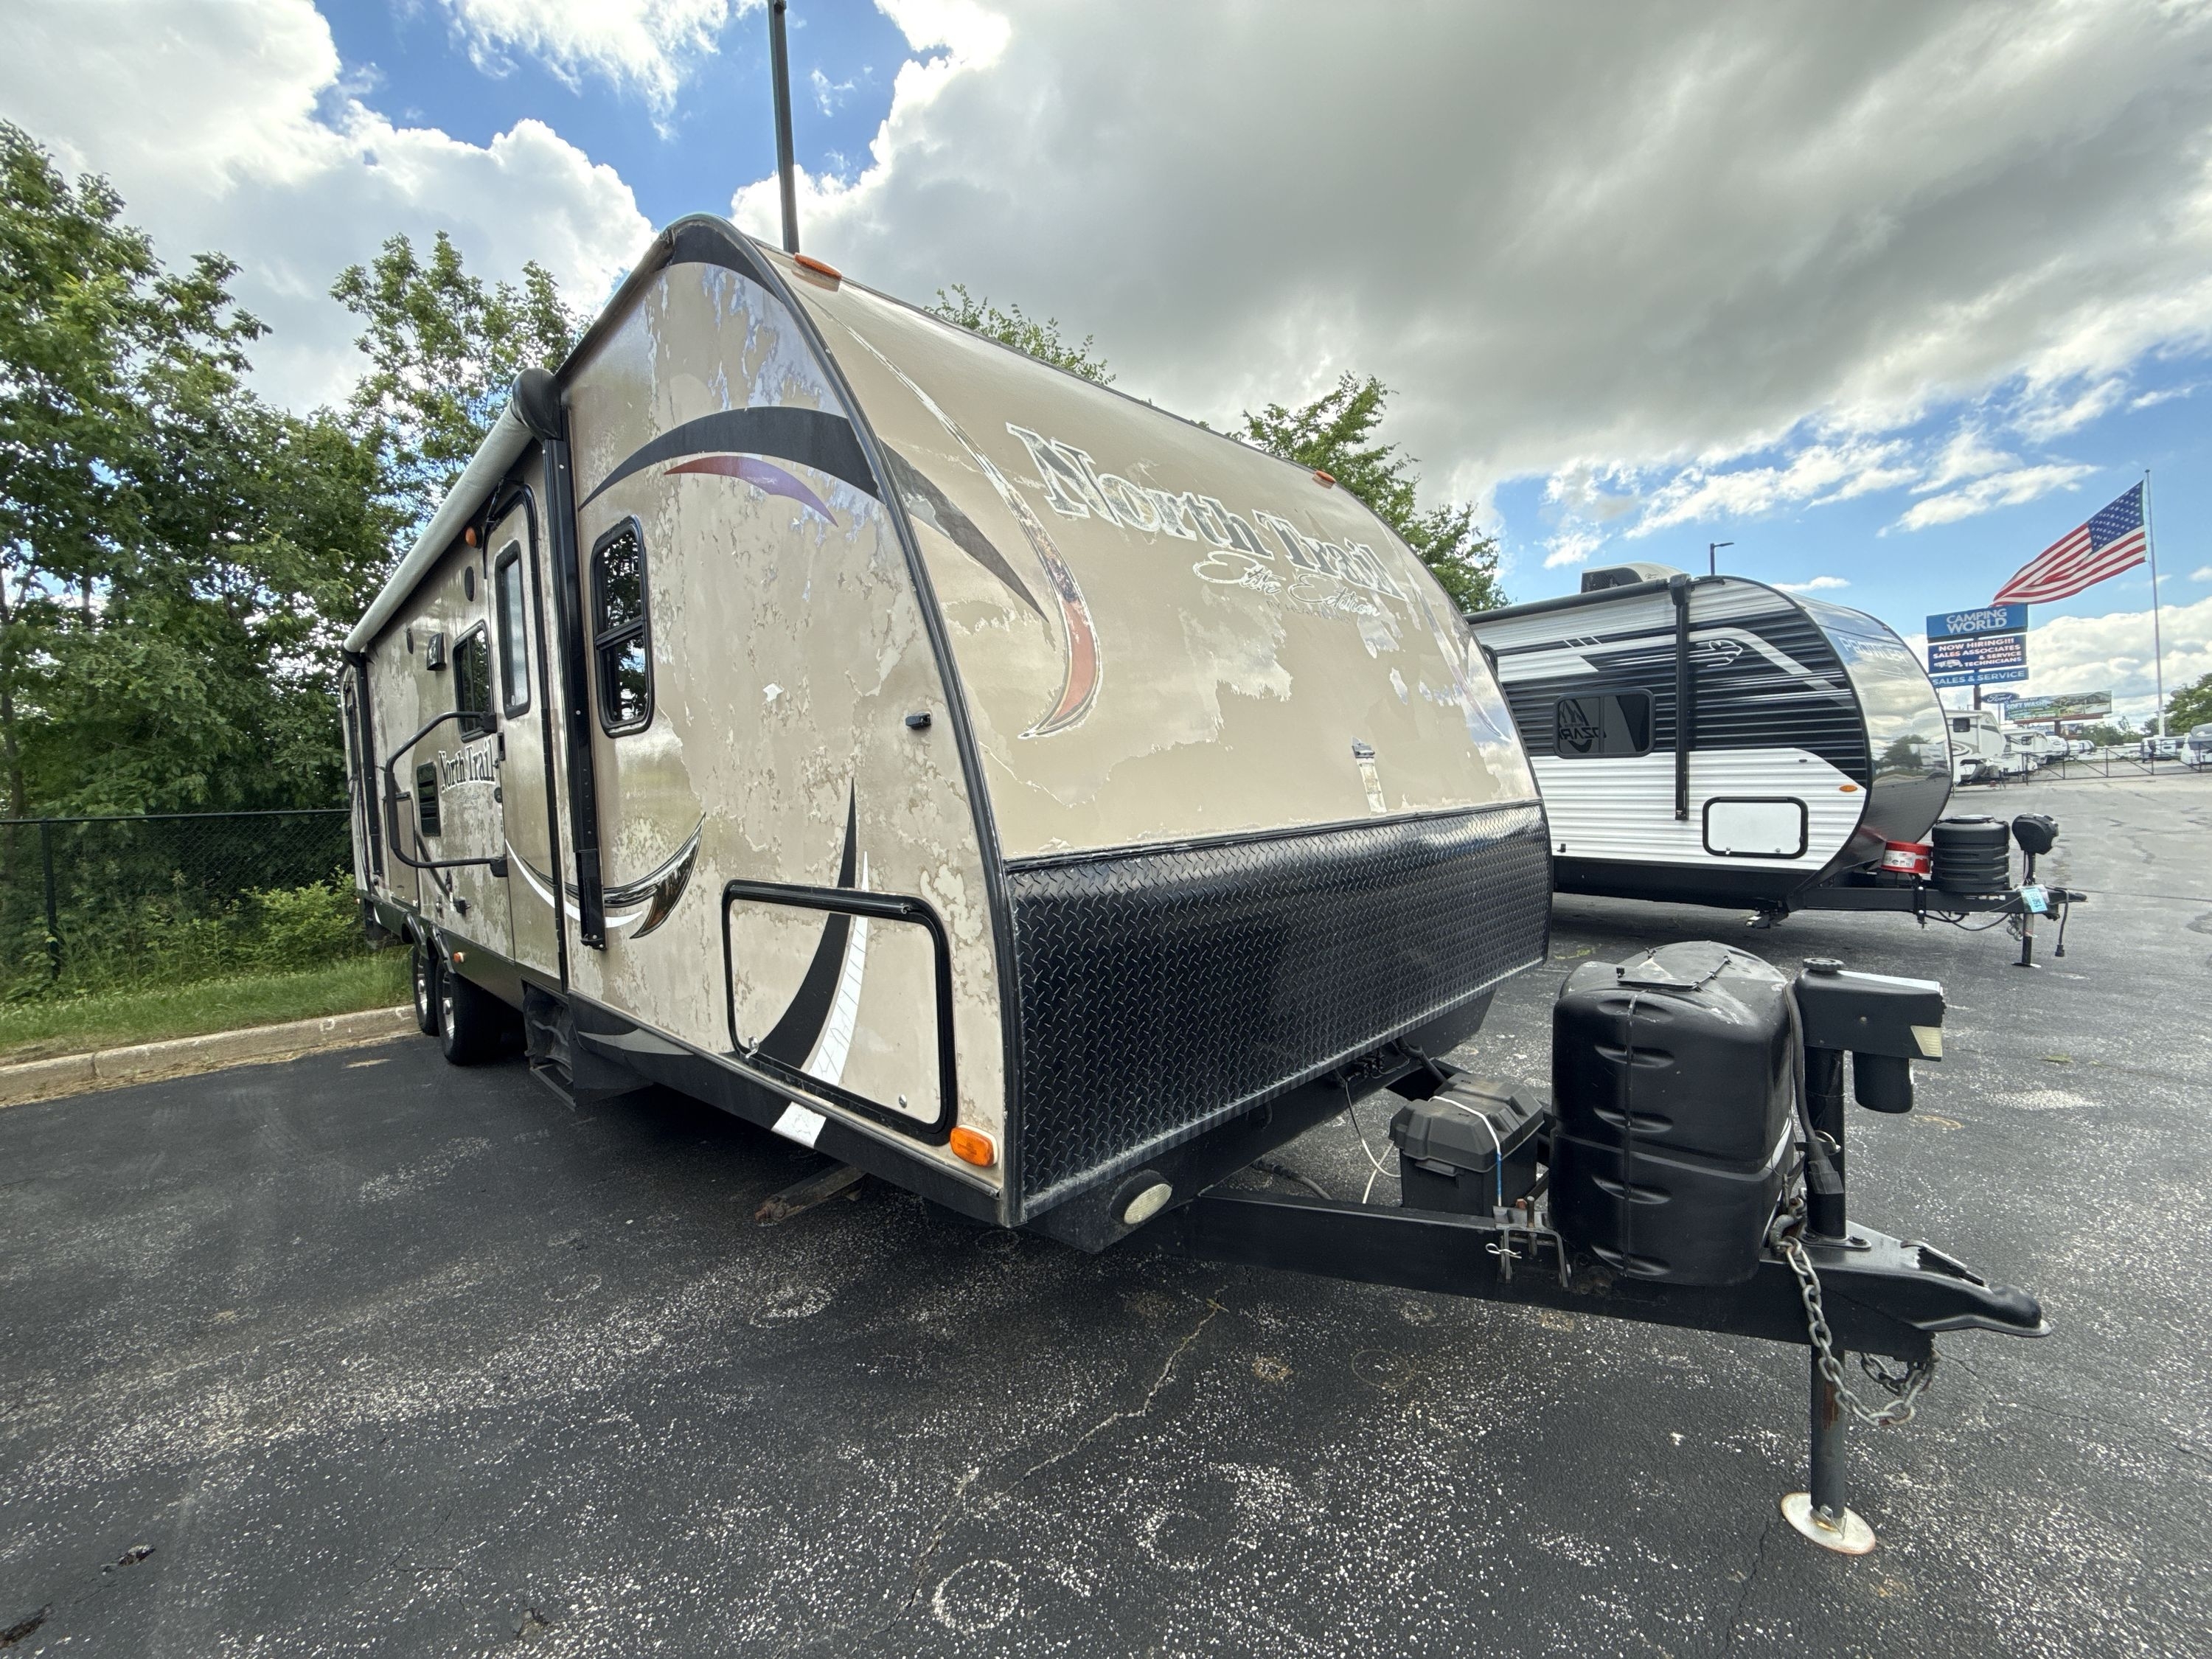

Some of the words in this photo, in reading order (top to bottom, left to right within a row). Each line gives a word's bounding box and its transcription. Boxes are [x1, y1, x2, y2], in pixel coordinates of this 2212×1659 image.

[1005, 421, 1275, 560] North
[1251, 509, 1406, 602] Trail
[1946, 608, 2007, 624] CAMPING
[1947, 617, 2007, 633] WORLD
[1838, 636, 1908, 664] PROWLER
[1933, 650, 1961, 659] SALES
[1962, 644, 2021, 655] ASSOCIATES
[1938, 643, 1964, 652] NOW
[1966, 638, 2014, 647] HIRING!!!
[1964, 656, 2023, 667] TECHNICIANS
[1932, 676, 1965, 686] SALES
[1977, 670, 2025, 680] SERVICE
[1987, 694, 2012, 702] Ford
[439, 750, 466, 793] North
[465, 735, 495, 785] Trail
